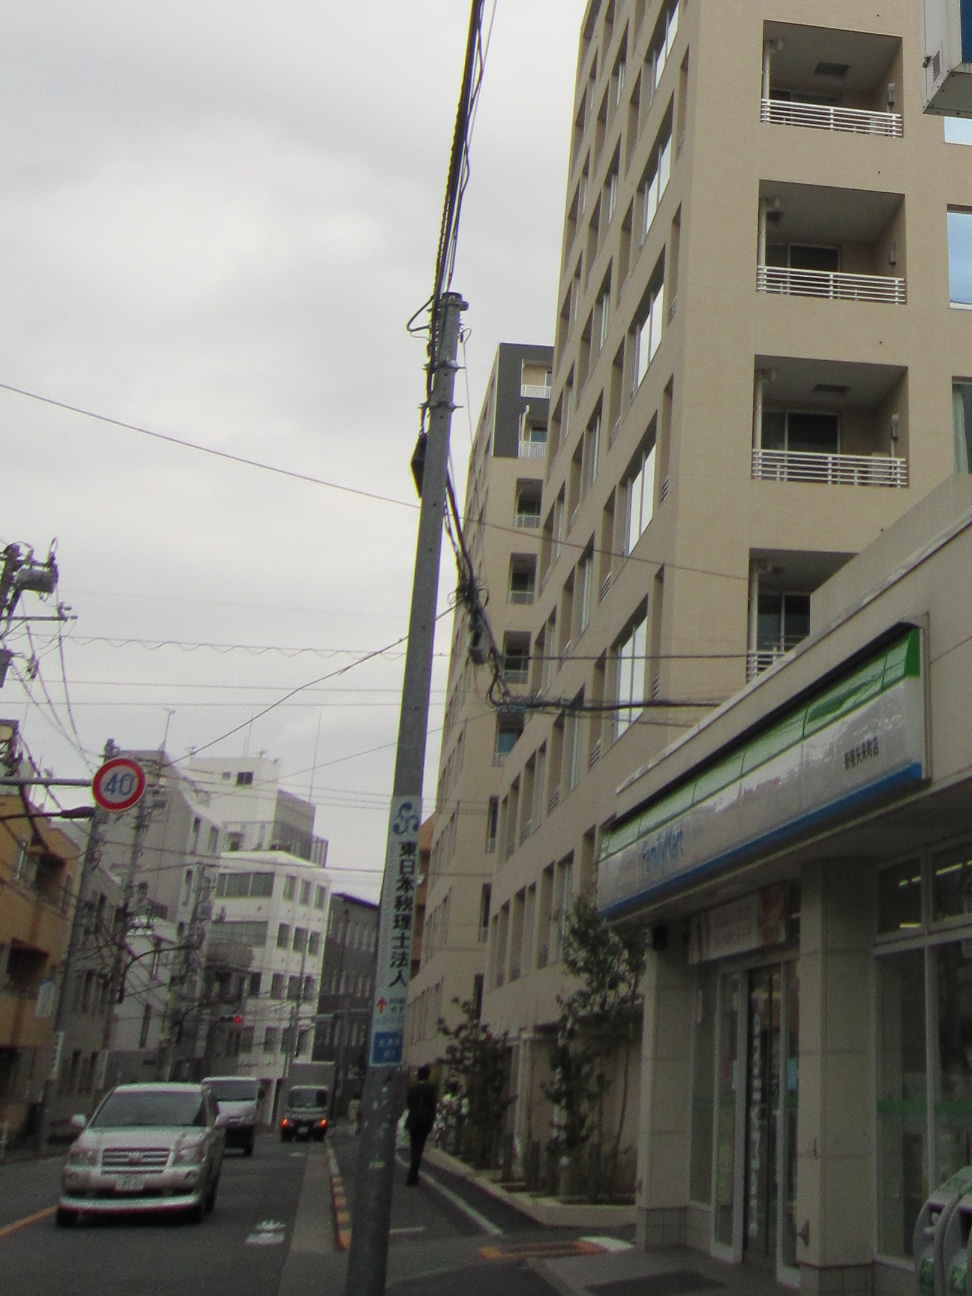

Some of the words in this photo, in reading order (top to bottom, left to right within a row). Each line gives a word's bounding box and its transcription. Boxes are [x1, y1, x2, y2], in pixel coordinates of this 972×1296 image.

[104, 772, 135, 796] 40
[388, 840, 418, 988] 東日本税理士法人
